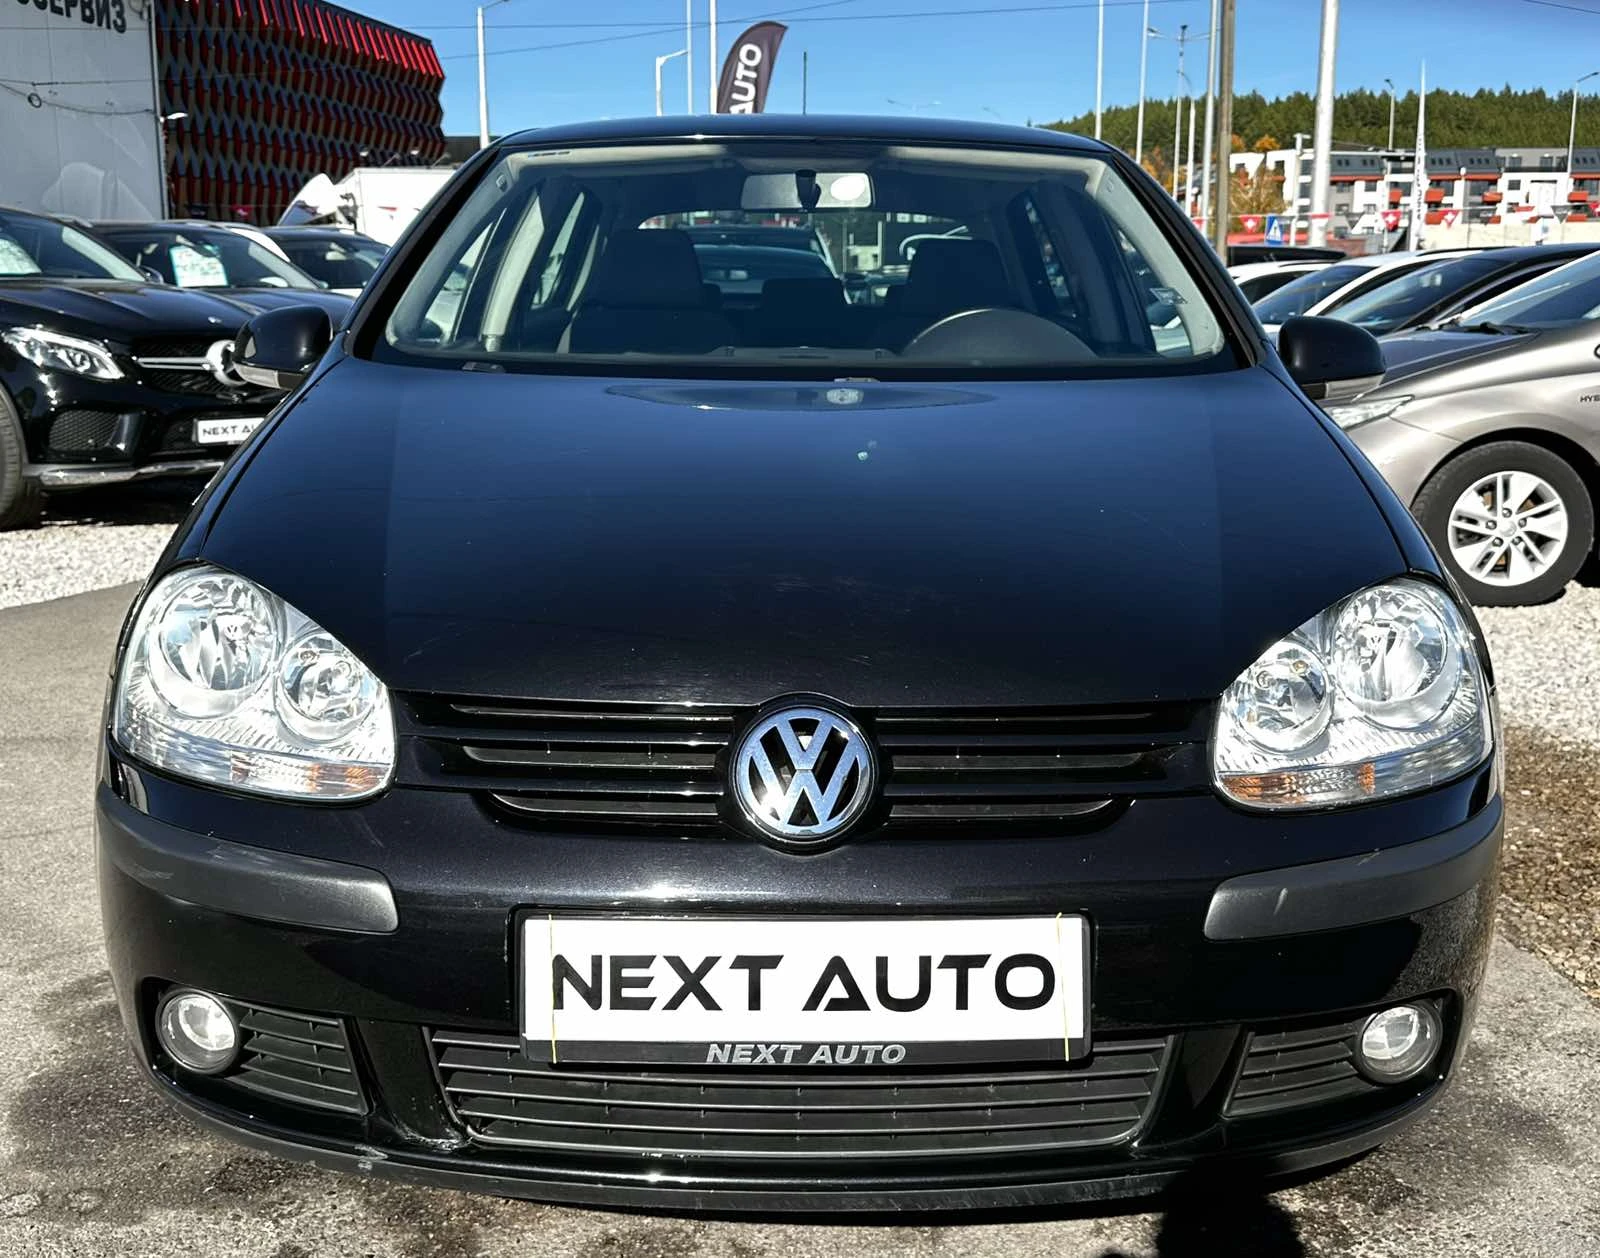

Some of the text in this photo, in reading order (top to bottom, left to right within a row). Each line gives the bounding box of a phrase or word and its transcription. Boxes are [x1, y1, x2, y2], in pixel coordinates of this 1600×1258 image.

[202, 425, 237, 436] NEXT
[552, 953, 1056, 1012] NEXT AUTO
[706, 1043, 907, 1064] NEXT AUTO
